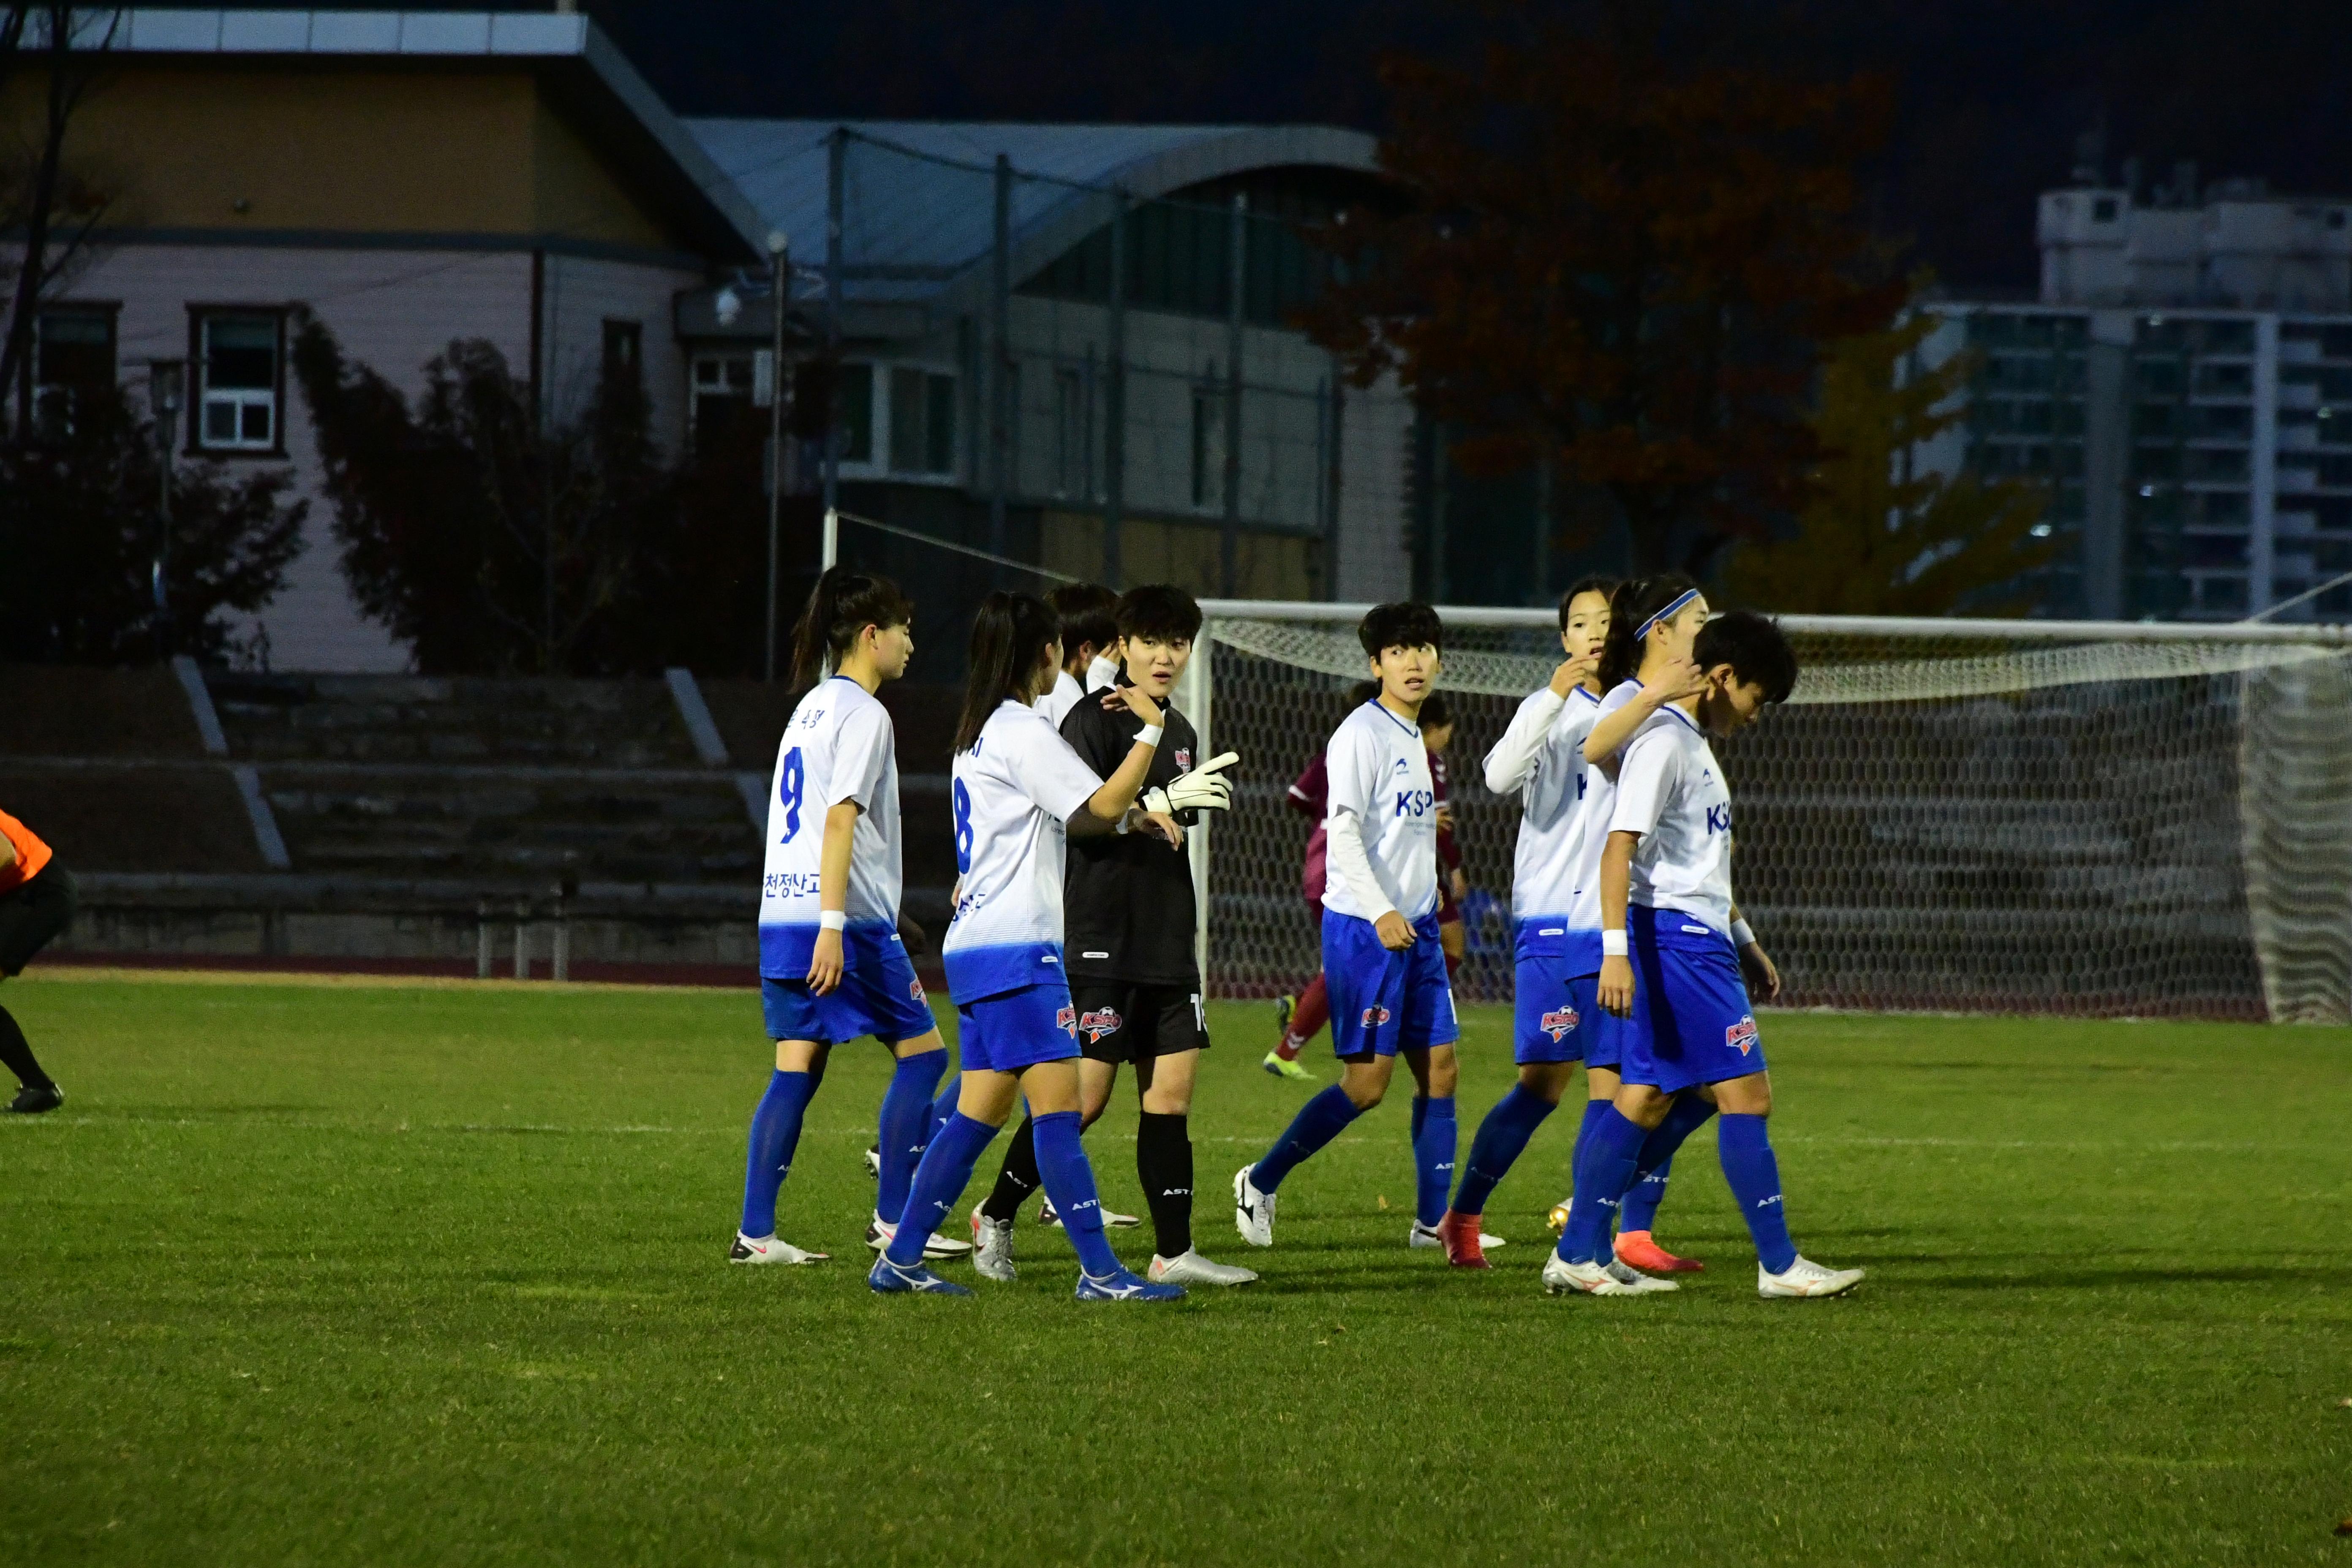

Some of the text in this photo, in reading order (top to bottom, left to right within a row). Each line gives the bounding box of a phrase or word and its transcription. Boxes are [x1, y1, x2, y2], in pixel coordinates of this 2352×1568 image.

[780, 747, 804, 844] 9
[954, 776, 973, 874] 8
[1082, 1015, 1122, 1027] KSPO
[1543, 1014, 1579, 1027] KSPO
[1072, 1200, 1097, 1210] AST
